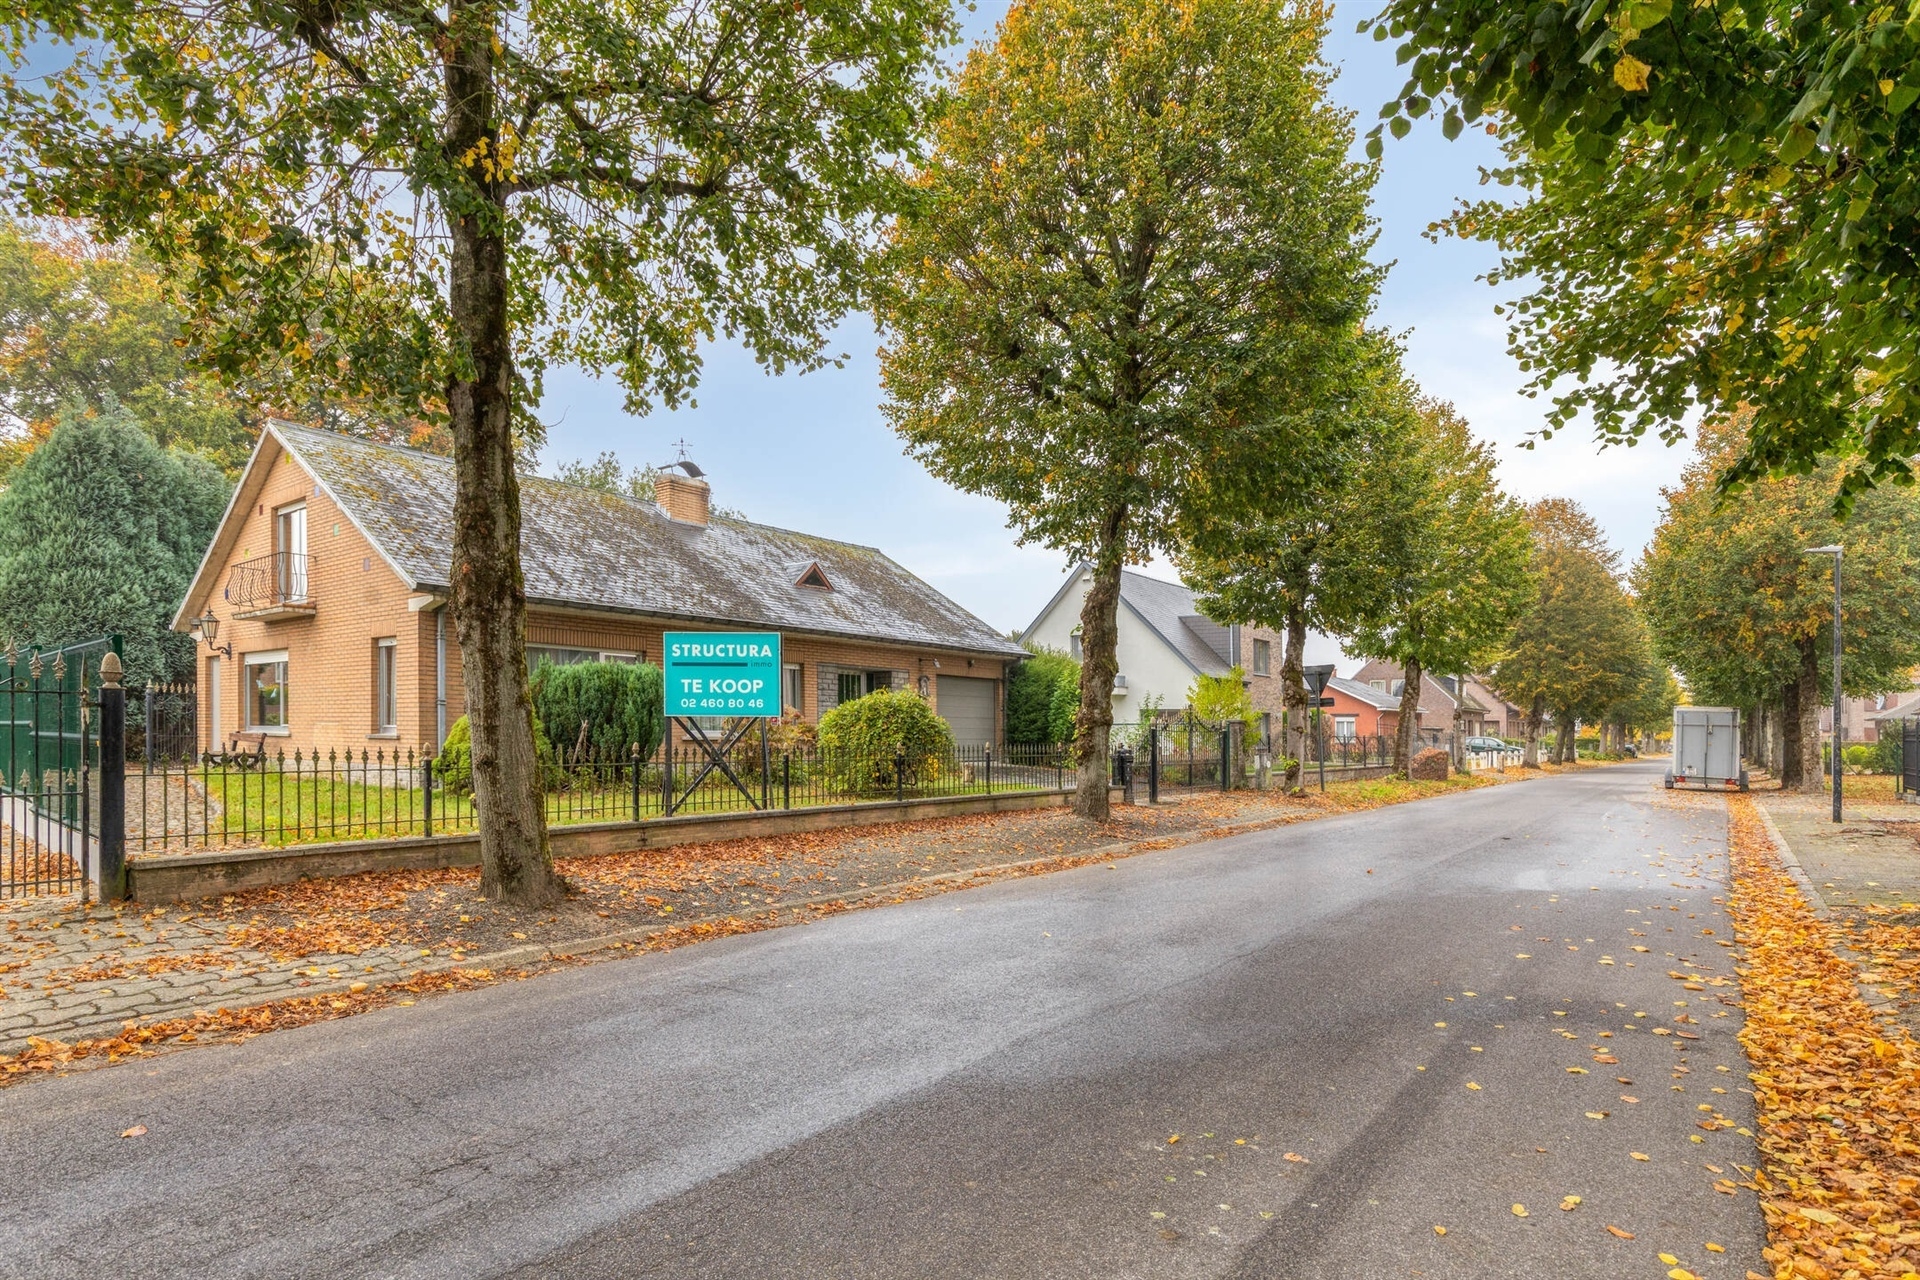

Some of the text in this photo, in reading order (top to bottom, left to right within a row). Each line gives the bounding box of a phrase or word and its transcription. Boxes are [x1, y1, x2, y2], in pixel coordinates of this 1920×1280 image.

[672, 644, 772, 657] STRUCTURA
[681, 679, 764, 693] TE KOOP
[681, 698, 764, 708] 02 460 80 46
